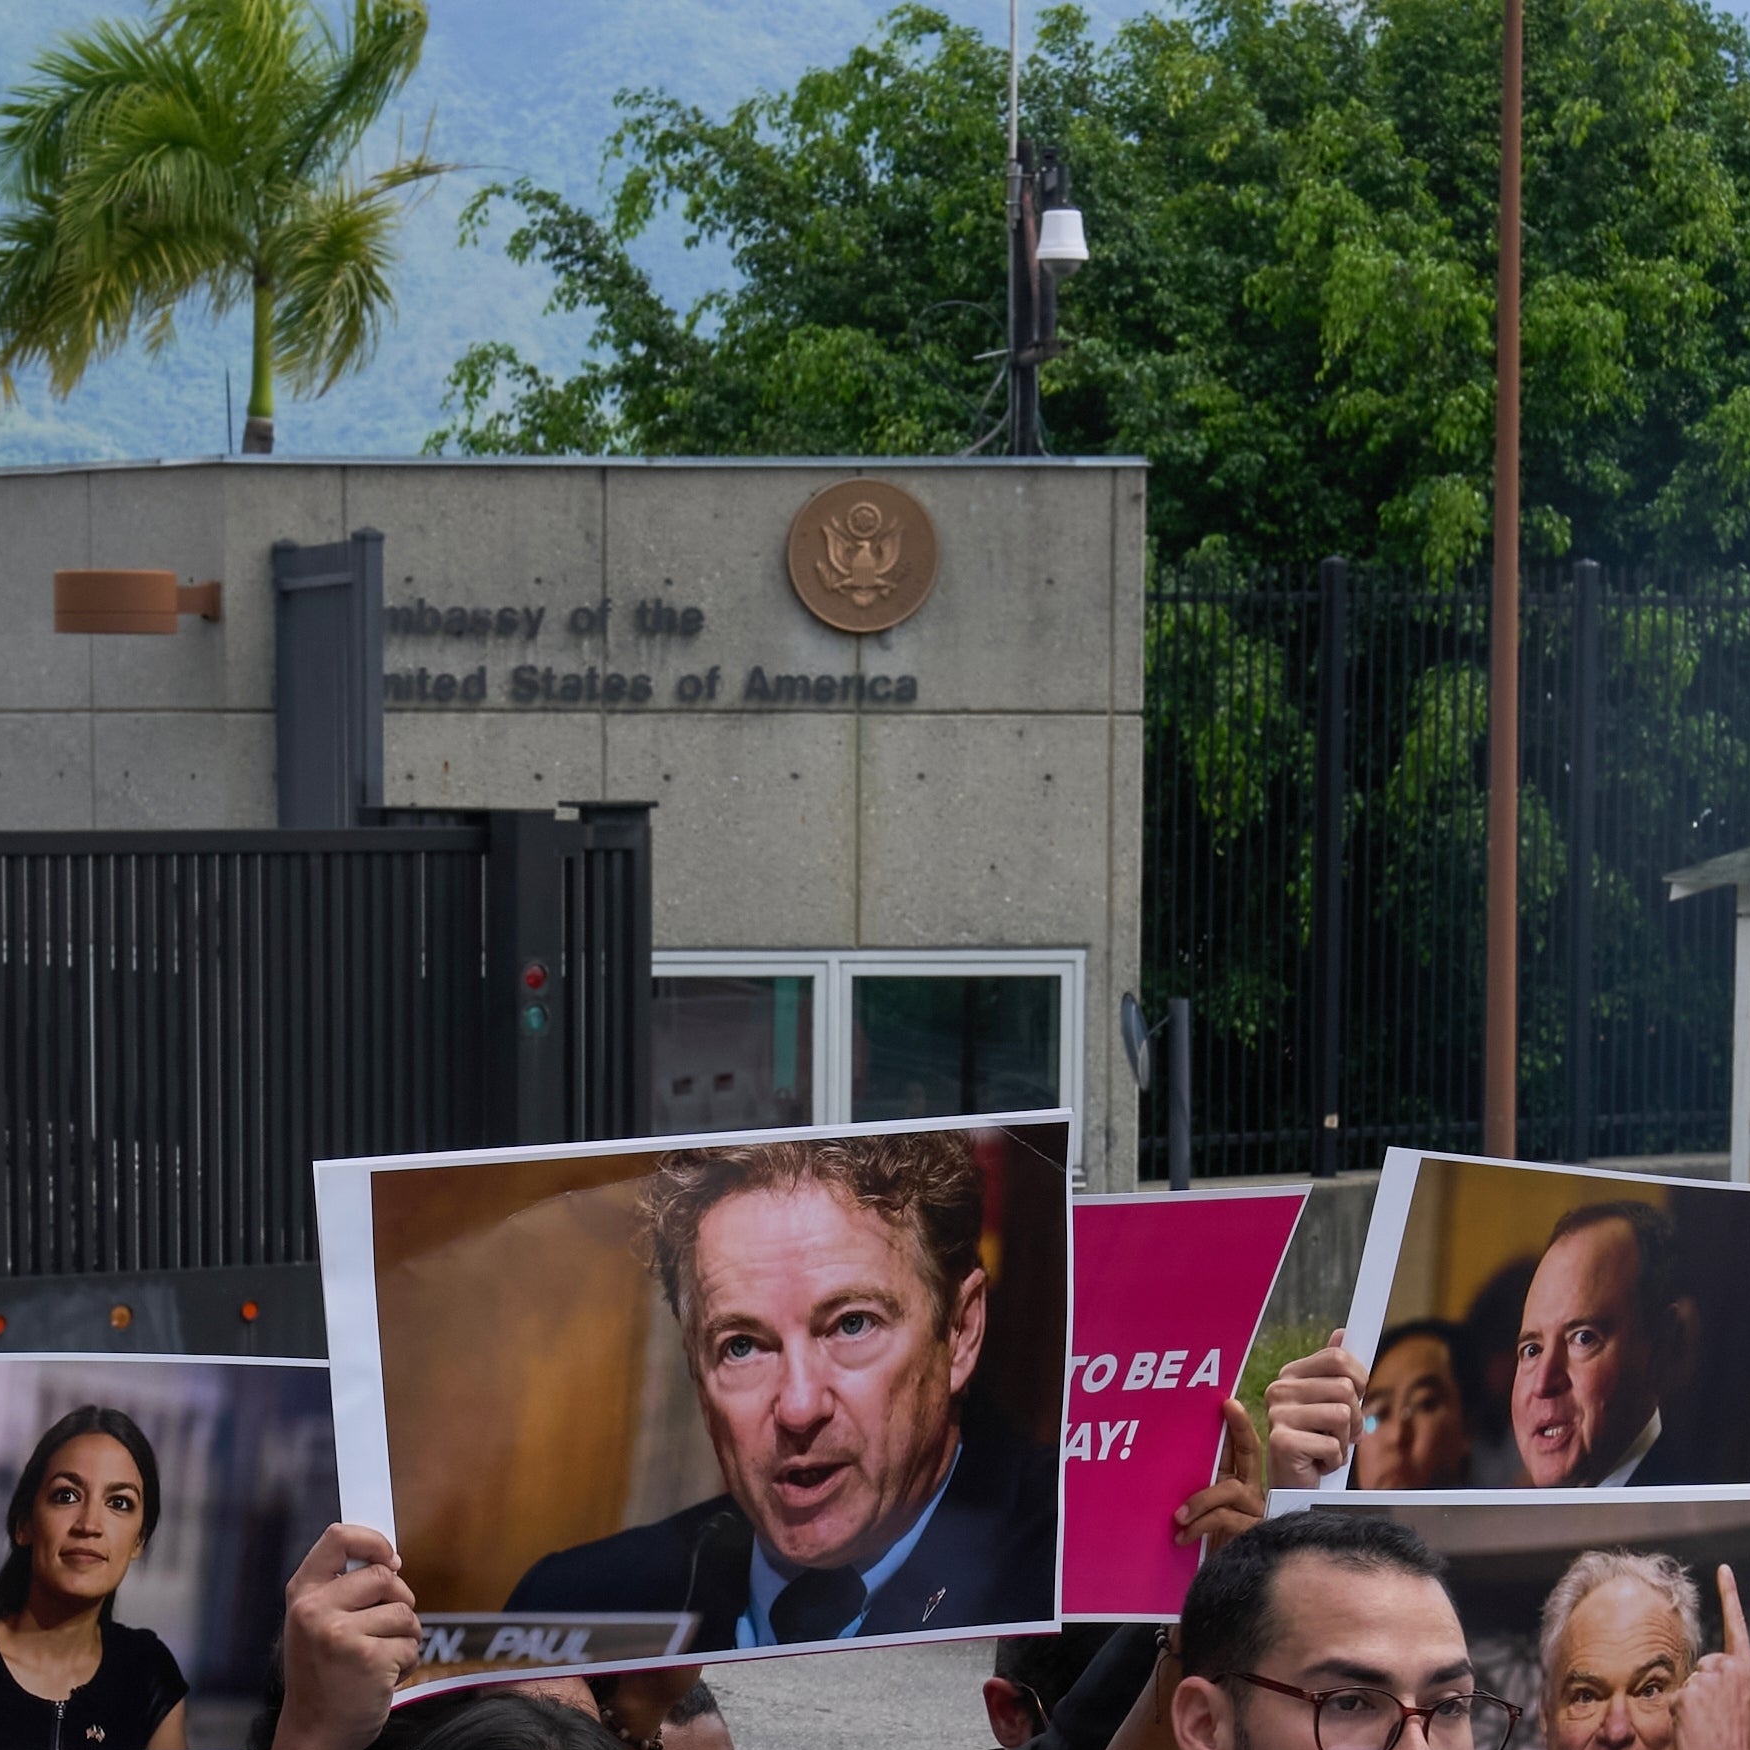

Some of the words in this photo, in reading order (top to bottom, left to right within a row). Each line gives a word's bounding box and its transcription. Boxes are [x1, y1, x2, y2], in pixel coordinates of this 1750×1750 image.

[383, 599, 545, 639] mbassy
[569, 599, 611, 637] of
[636, 599, 704, 637] the
[383, 667, 487, 700] nited
[511, 665, 652, 701] States
[677, 666, 721, 701] of
[744, 665, 919, 701] America
[1122, 1349, 1189, 1391] BE
[1187, 1348, 1221, 1388] A
[1064, 1420, 1140, 1462] AY!
[483, 1626, 595, 1664] PAUL
